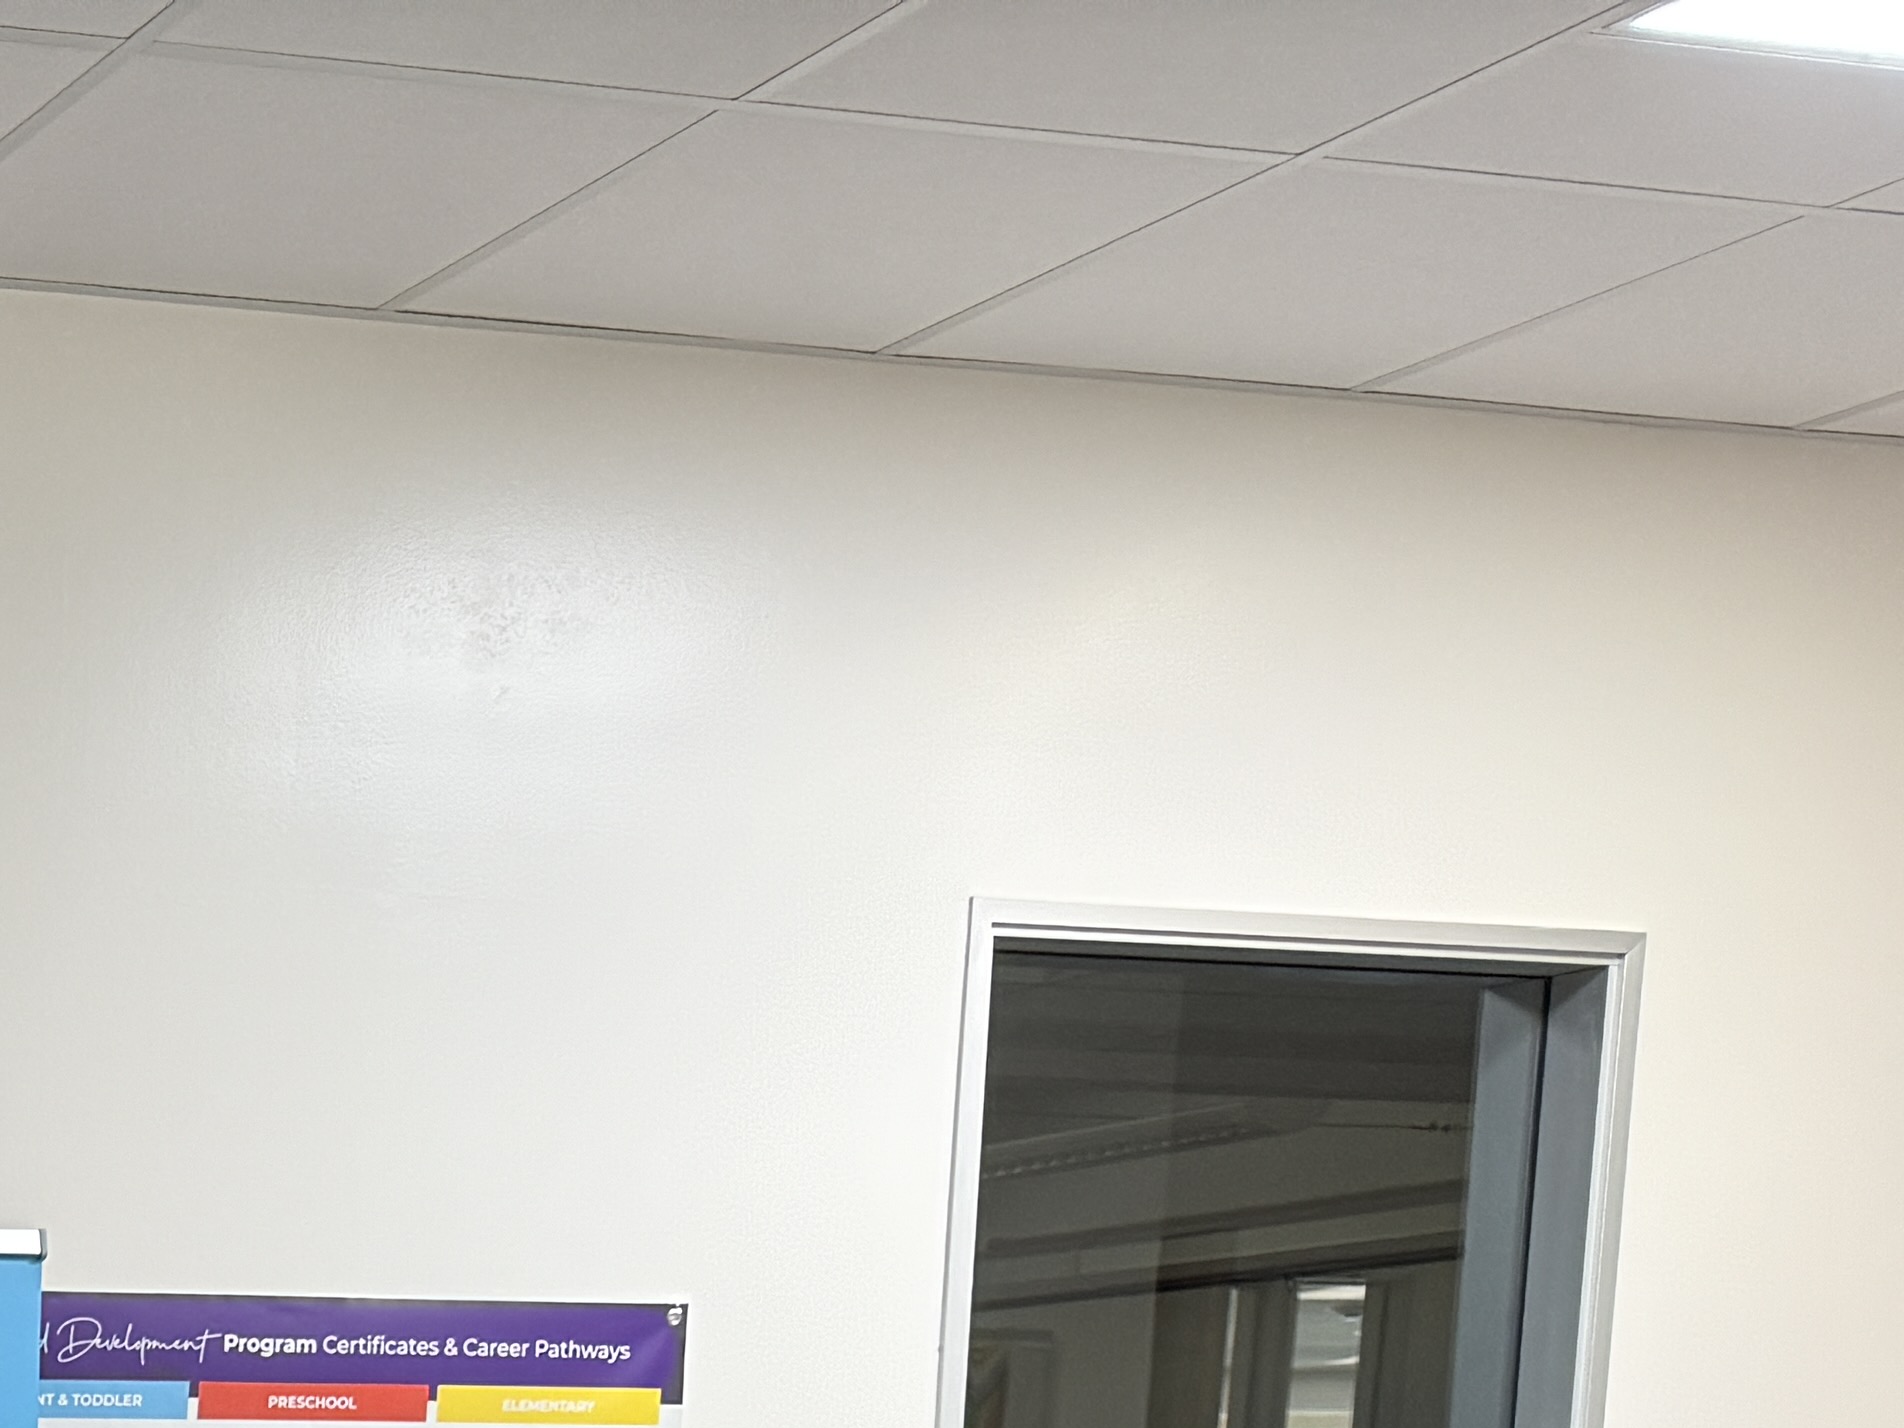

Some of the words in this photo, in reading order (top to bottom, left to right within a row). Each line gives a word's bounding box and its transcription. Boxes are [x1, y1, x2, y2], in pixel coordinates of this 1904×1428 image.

[57, 1317, 222, 1365] Development
[223, 1334, 316, 1357] Program
[323, 1335, 439, 1356] Certificates
[444, 1339, 458, 1356] &
[463, 1338, 530, 1358] Career
[535, 1339, 631, 1364] Pathways
[58, 1394, 68, 1405] &
[72, 1393, 142, 1406] TODDLER
[268, 1395, 357, 1410] PRESCHOOL
[502, 1400, 596, 1413] ELEMENTARY
